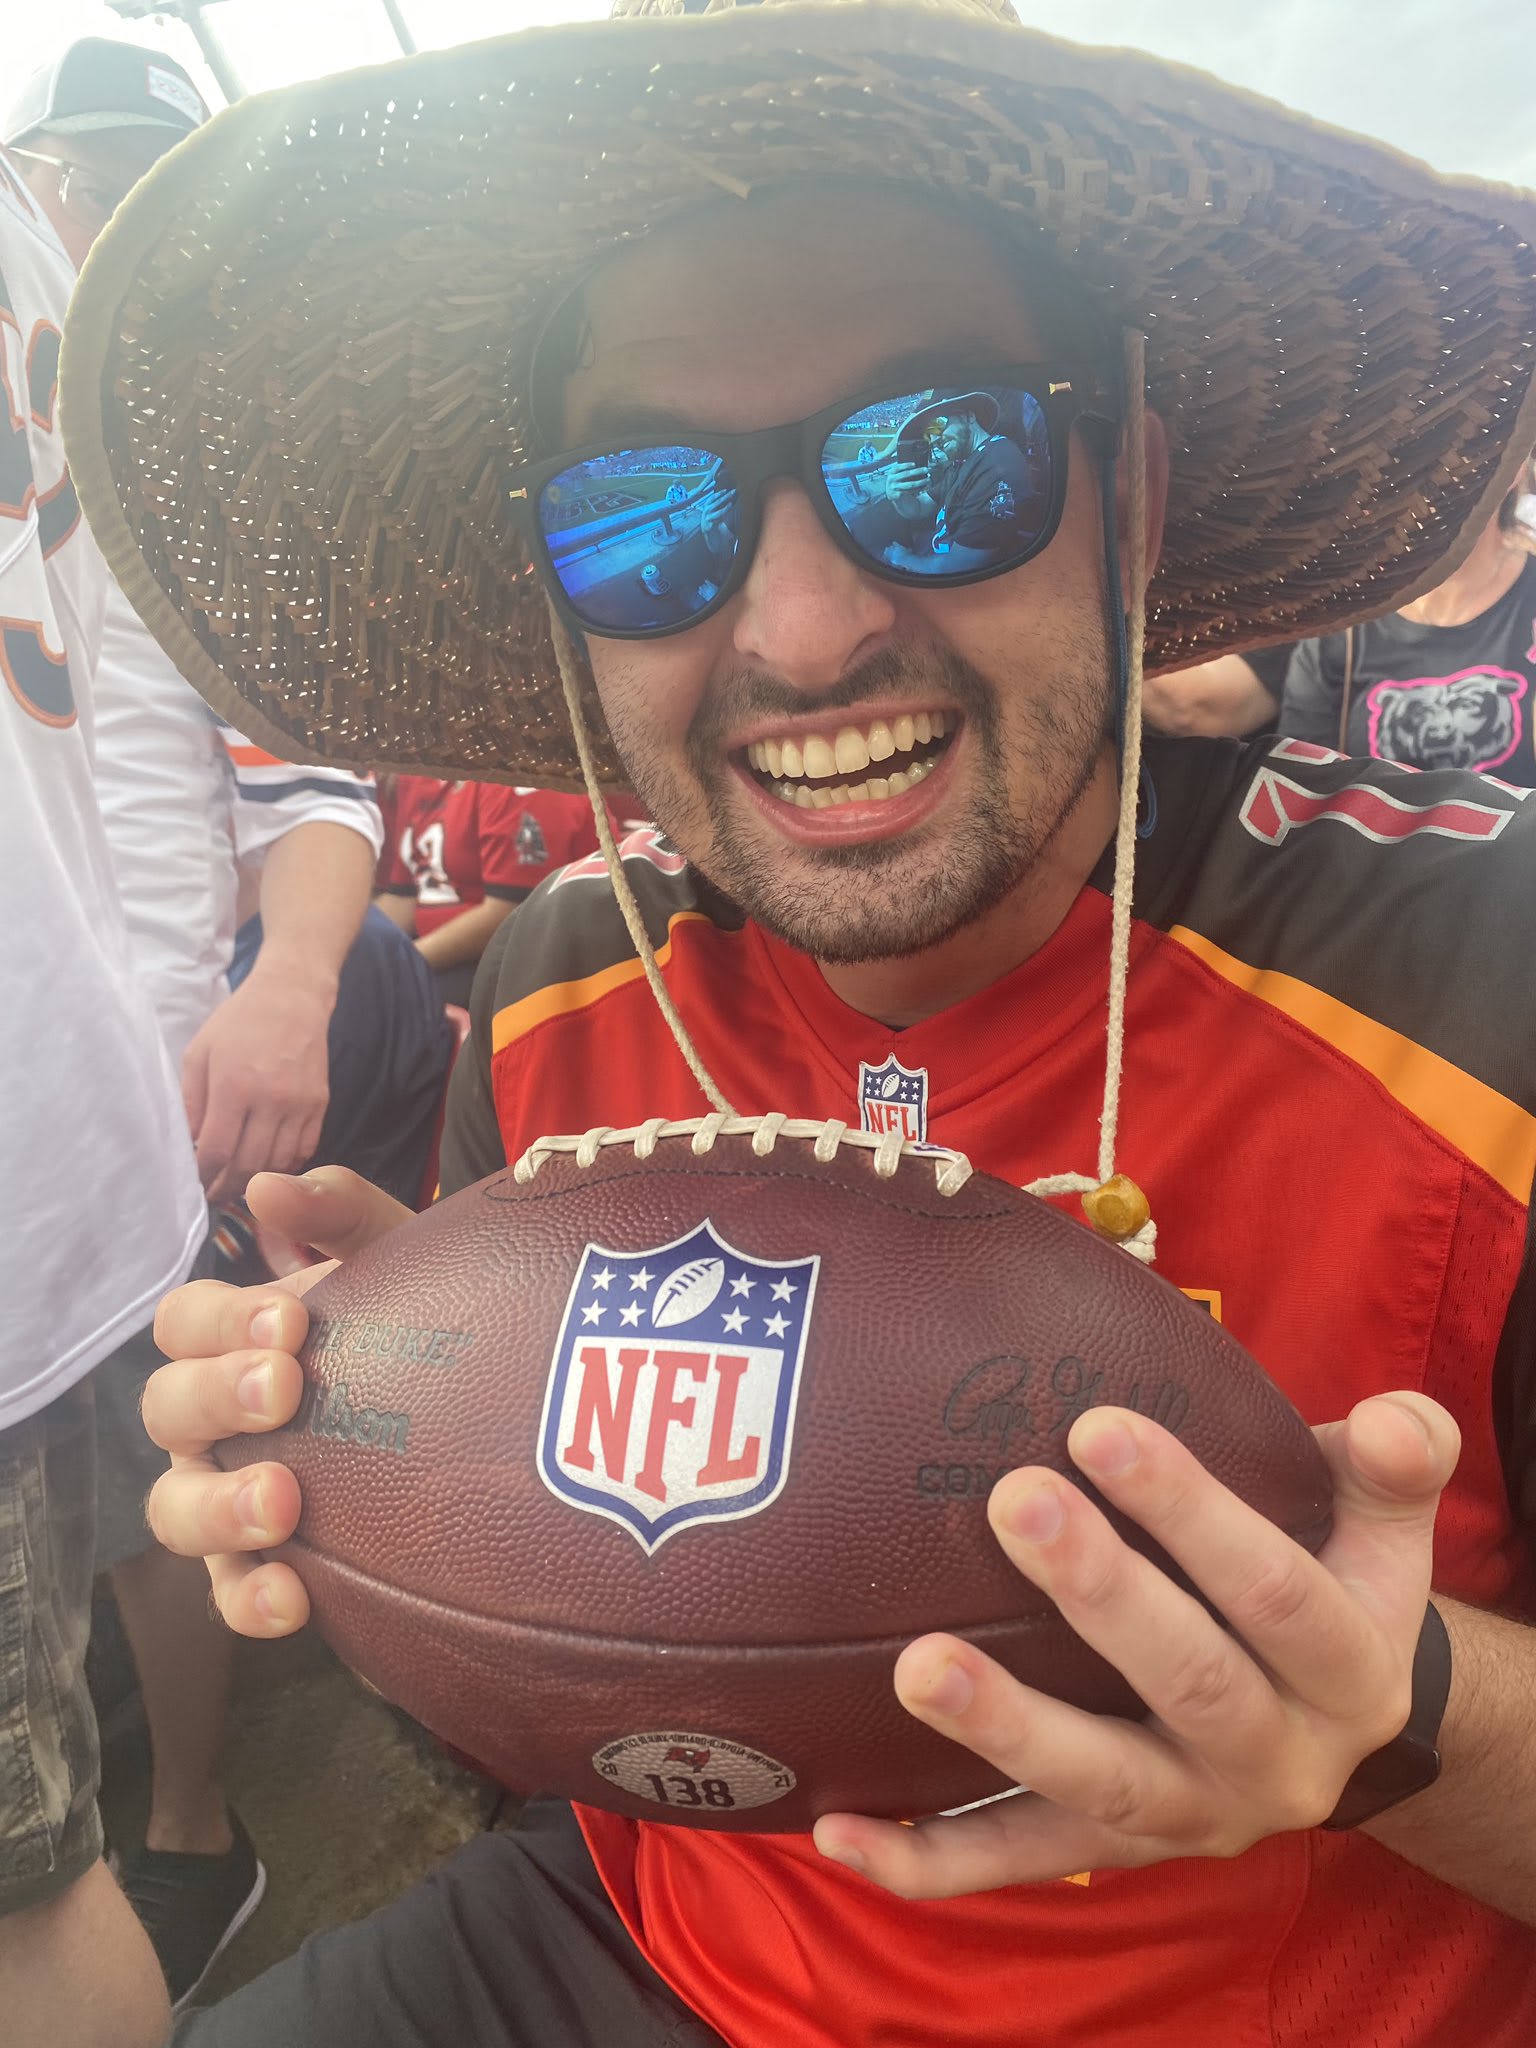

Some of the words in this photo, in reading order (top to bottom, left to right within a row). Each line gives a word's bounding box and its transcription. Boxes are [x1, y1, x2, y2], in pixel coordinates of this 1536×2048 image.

[866, 1102, 917, 1141] NFL
[563, 1347, 761, 1504] NFL
[601, 1763, 618, 1776] 20
[773, 1774, 791, 1788] 21
[644, 1773, 736, 1808] 138
